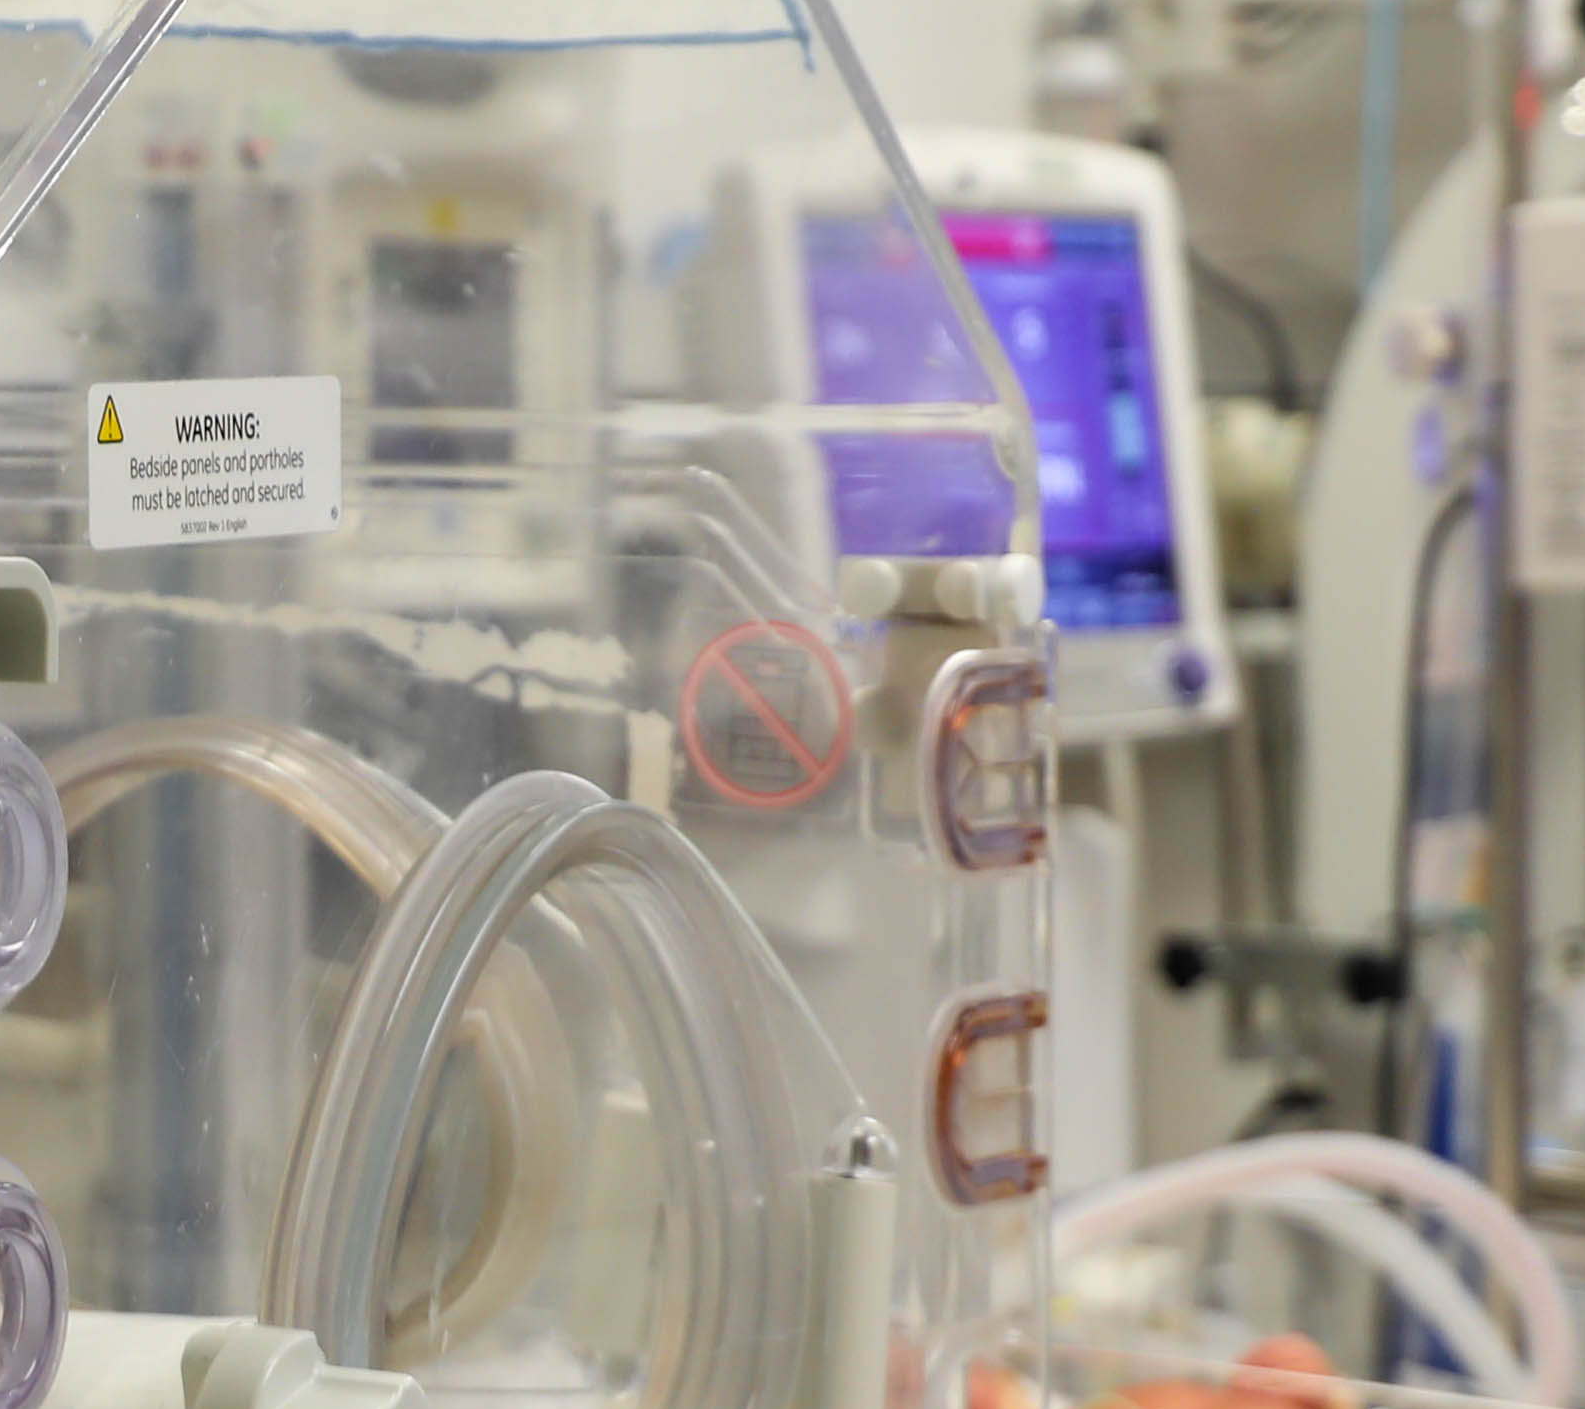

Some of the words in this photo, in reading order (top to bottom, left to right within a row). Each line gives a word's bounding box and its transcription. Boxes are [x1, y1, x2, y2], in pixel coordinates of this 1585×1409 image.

[175, 412, 260, 444] WARNING:
[130, 454, 178, 479] Bedside
[181, 450, 221, 481] panels
[223, 448, 246, 473] and
[250, 446, 304, 476] portholes
[132, 488, 164, 511] must
[167, 485, 182, 509] be
[185, 482, 229, 508] latched
[232, 479, 255, 505] and
[258, 477, 306, 502] secured.
